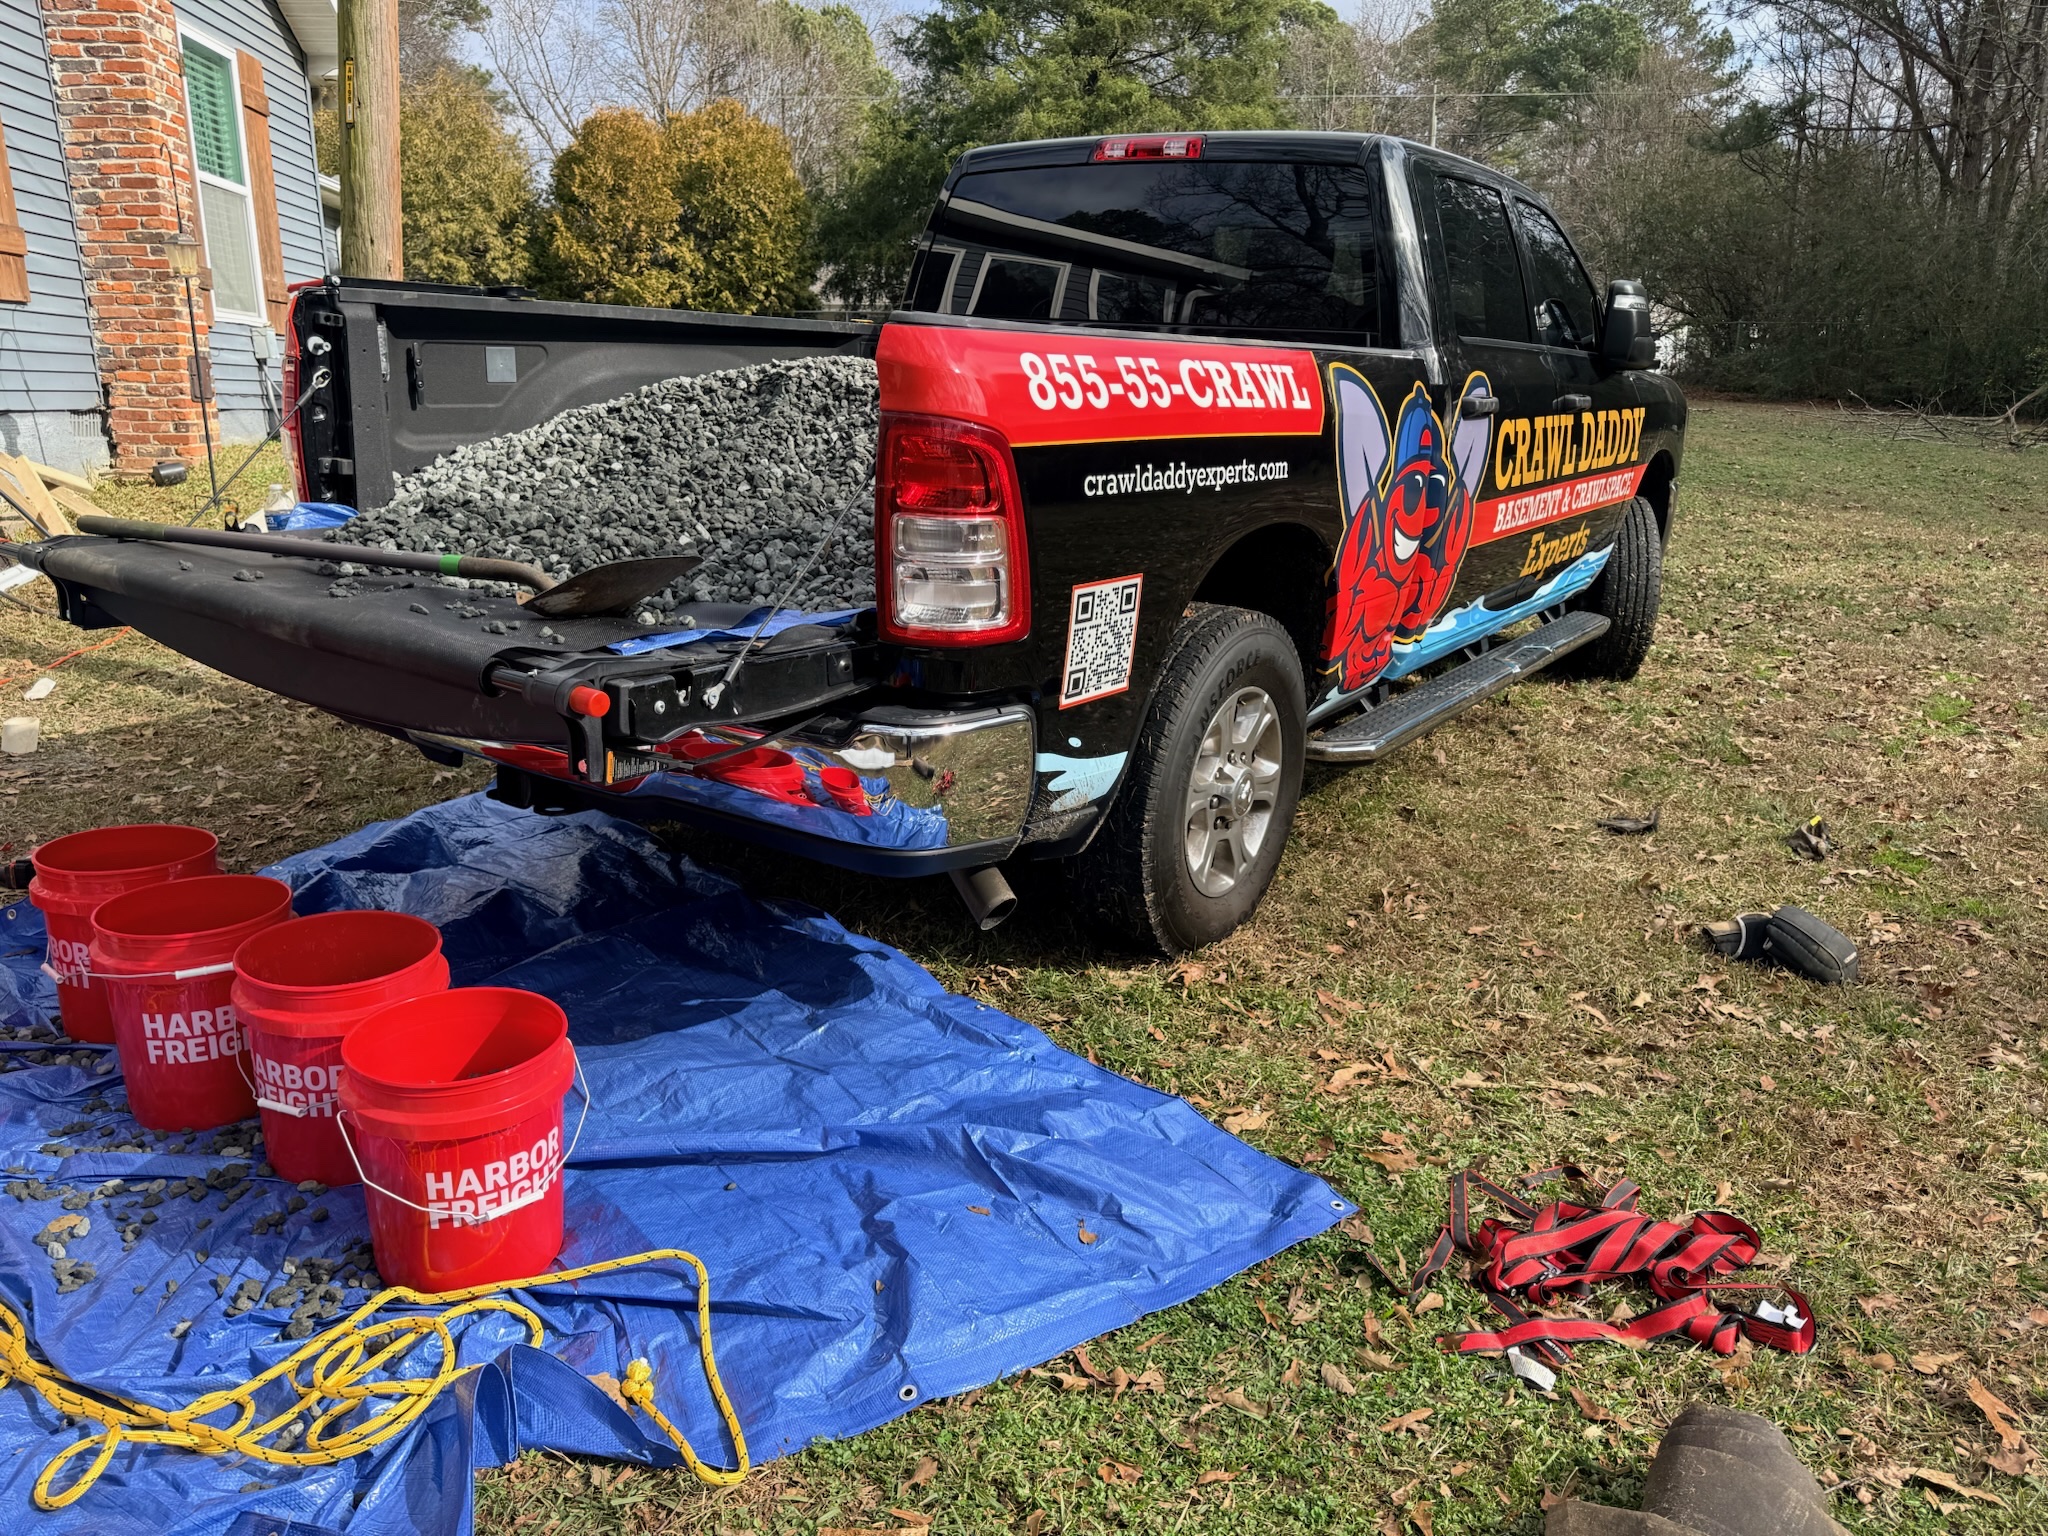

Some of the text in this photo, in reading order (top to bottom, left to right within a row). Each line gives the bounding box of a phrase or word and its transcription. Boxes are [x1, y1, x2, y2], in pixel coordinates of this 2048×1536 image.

[1019, 352, 1312, 411] 855-55-CRAWL
[1084, 458, 1289, 497] crawldaddyexperts.com
[1495, 407, 1646, 491] CRAWL DADDY
[1493, 472, 1635, 534] BASEMENT & CRAWLSPACE
[1518, 519, 1591, 582] Experts
[49, 935, 91, 967] BOR
[142, 1004, 236, 1039] HARB
[146, 1026, 251, 1065] FREIG
[425, 1126, 560, 1201] HARBOR
[428, 1150, 560, 1230] FREIGHT
